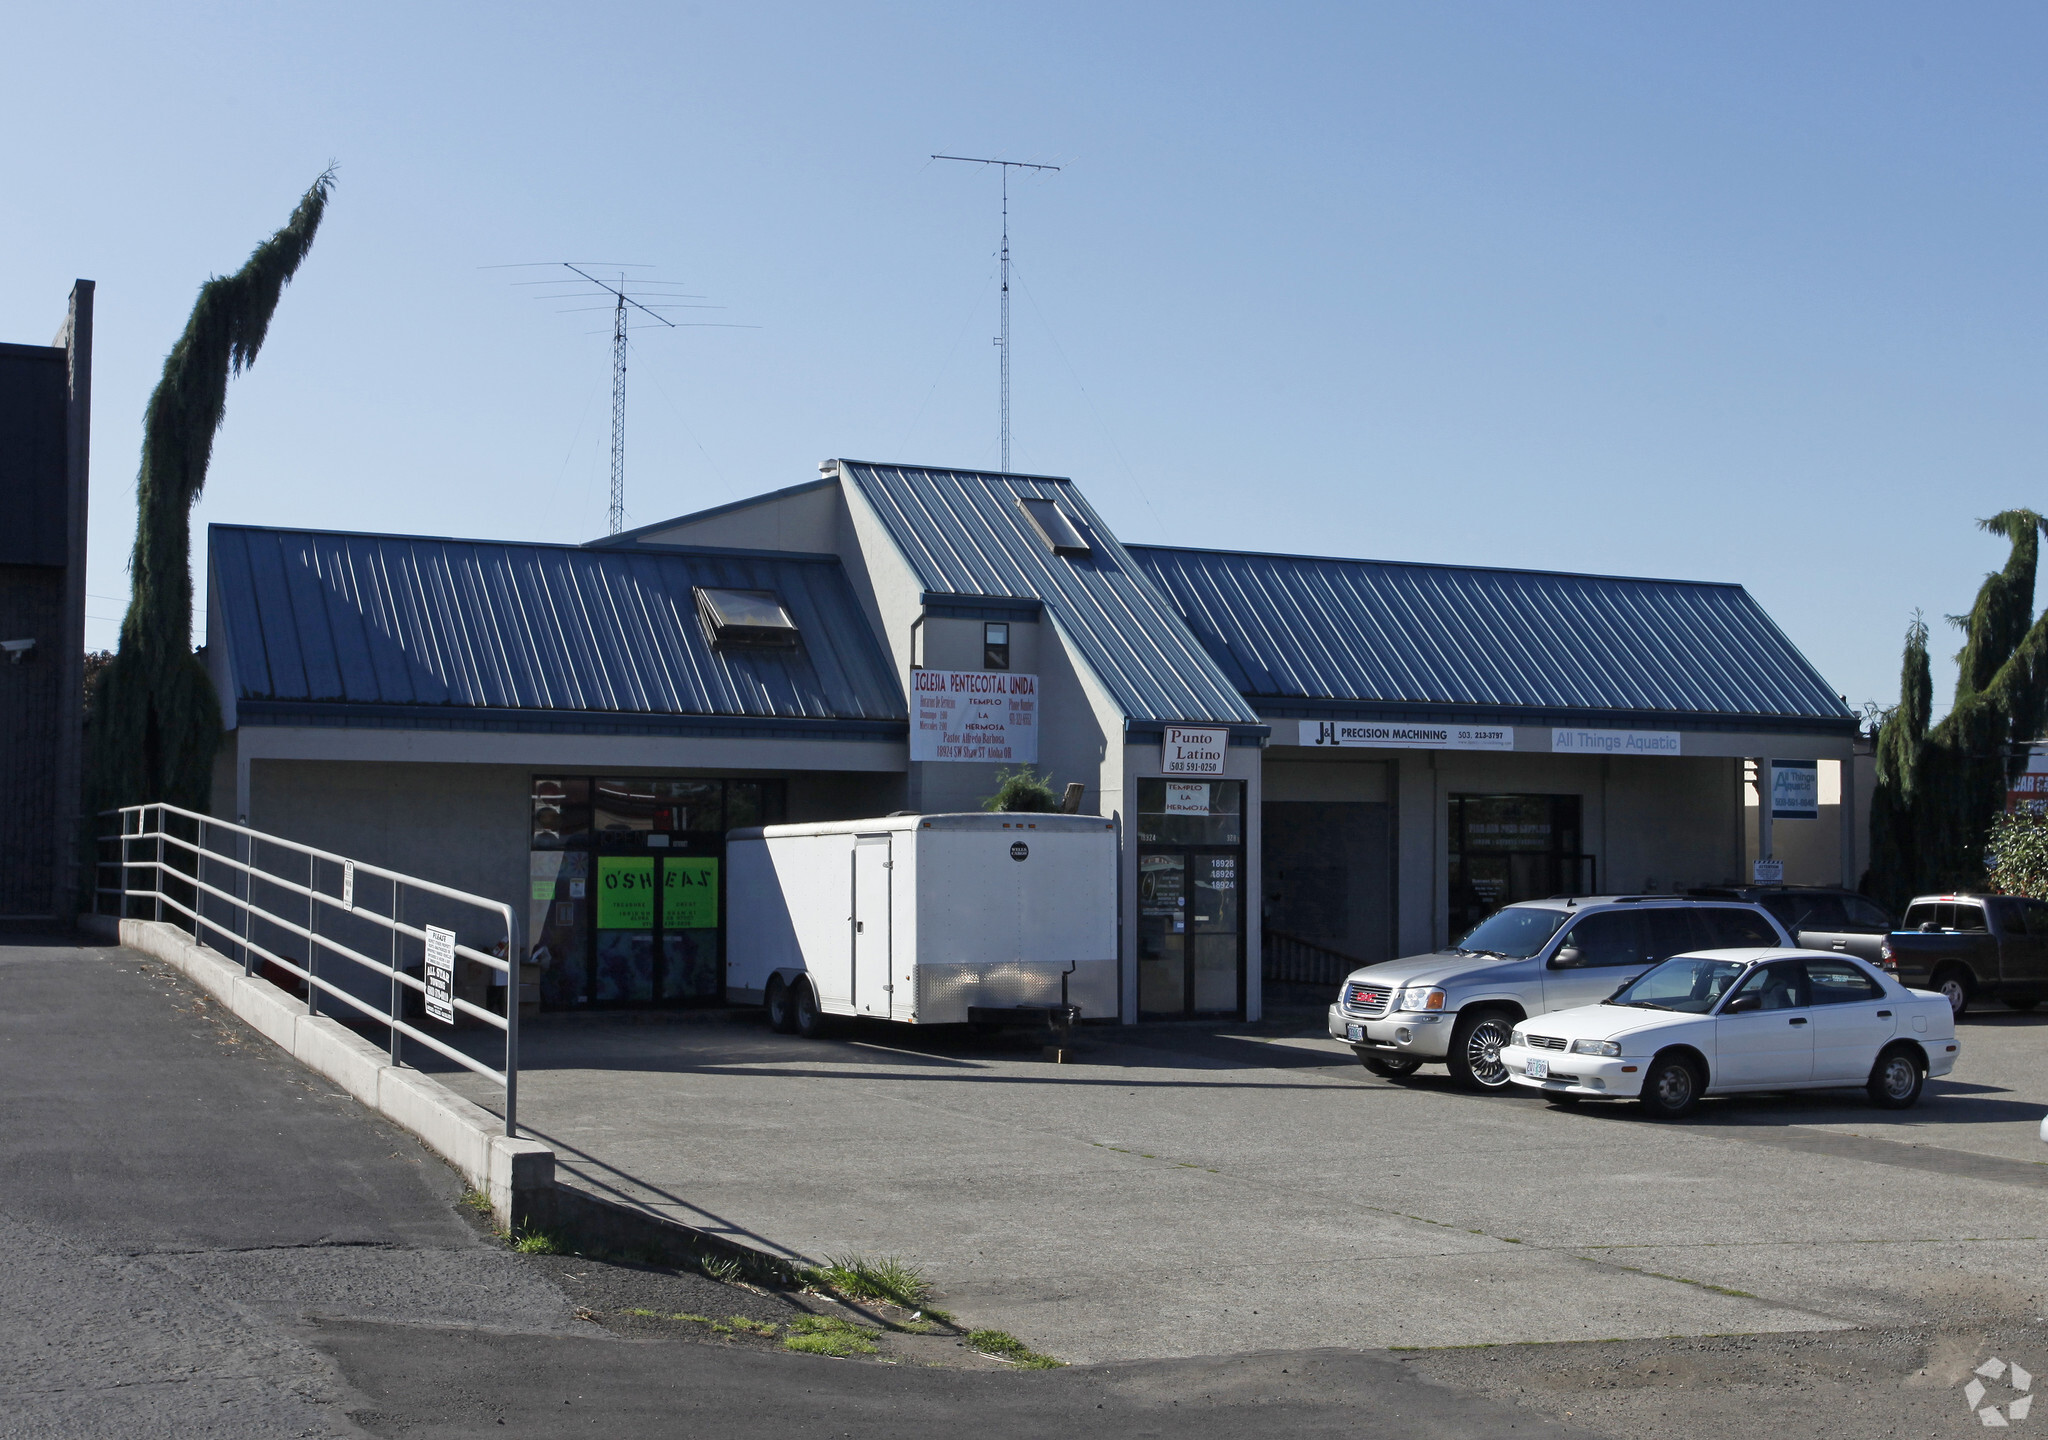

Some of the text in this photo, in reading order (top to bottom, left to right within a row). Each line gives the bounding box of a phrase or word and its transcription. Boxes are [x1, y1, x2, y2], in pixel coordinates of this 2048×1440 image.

[915, 672, 1034, 695] IGLESIA PENTECOSTAL UNIDA
[969, 698, 1002, 706] TEMPLO
[965, 723, 1005, 731] HERMOSA
[943, 731, 1005, 744] Pastor Alfredo Barbosa
[1171, 730, 1212, 744] Punto
[1341, 727, 1389, 739] PRECISION
[1392, 729, 1448, 740] MACHINING
[1475, 732, 1503, 740] 213-3797
[1556, 732, 1677, 752] All Things Aquatic
[954, 746, 962, 758] SW
[963, 746, 977, 758] Shaw
[978, 747, 985, 758] ST
[988, 747, 1003, 758] Aloha
[1003, 747, 1012, 758] OR
[1176, 746, 1220, 760] Latino
[1169, 761, 1217, 771] (503) 591-0250
[1166, 804, 1209, 812] HERMOSA
[1211, 859, 1234, 867] 18928
[1211, 870, 1234, 878] 18926
[1211, 881, 1234, 889] 18924
[1357, 992, 1377, 1003] GMC
